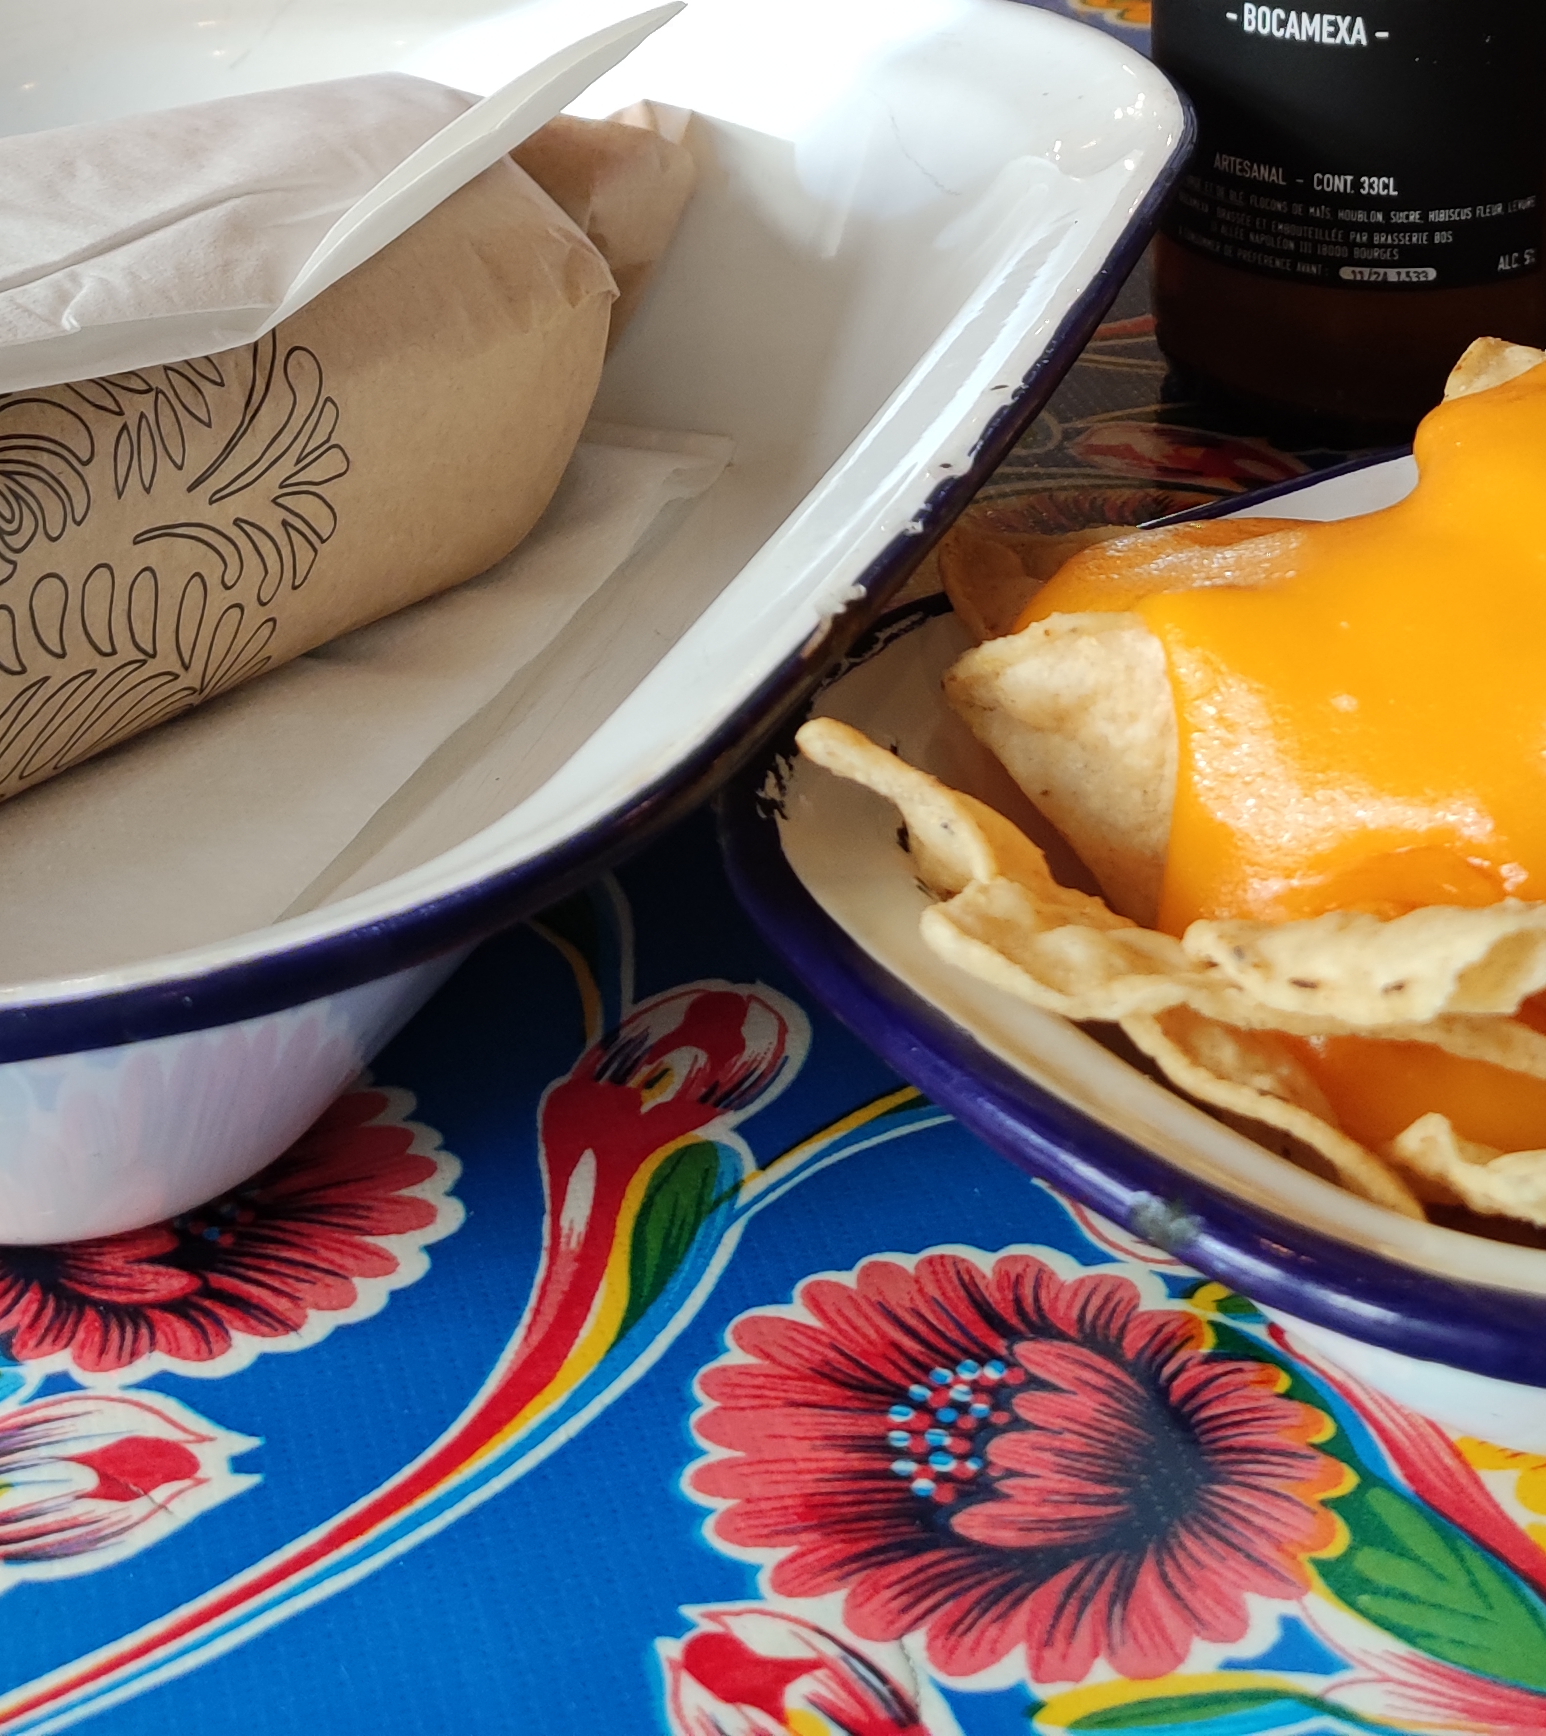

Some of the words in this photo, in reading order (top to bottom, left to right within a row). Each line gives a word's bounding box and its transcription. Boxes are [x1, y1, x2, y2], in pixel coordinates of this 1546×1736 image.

[1243, 2, 1367, 46] BOCAMEXA
[1213, 151, 1287, 186] ARTESANAL
[1313, 173, 1355, 194] CONT.
[1359, 176, 1399, 196] 33CL
[1249, 194, 1288, 213] FLOCONS
[1291, 203, 1304, 216] DE
[1428, 206, 1473, 223] HIBISCUS
[1349, 231, 1368, 244] PAR
[1373, 231, 1429, 245] BRASSERIE
[1353, 246, 1399, 260] BOURGES
